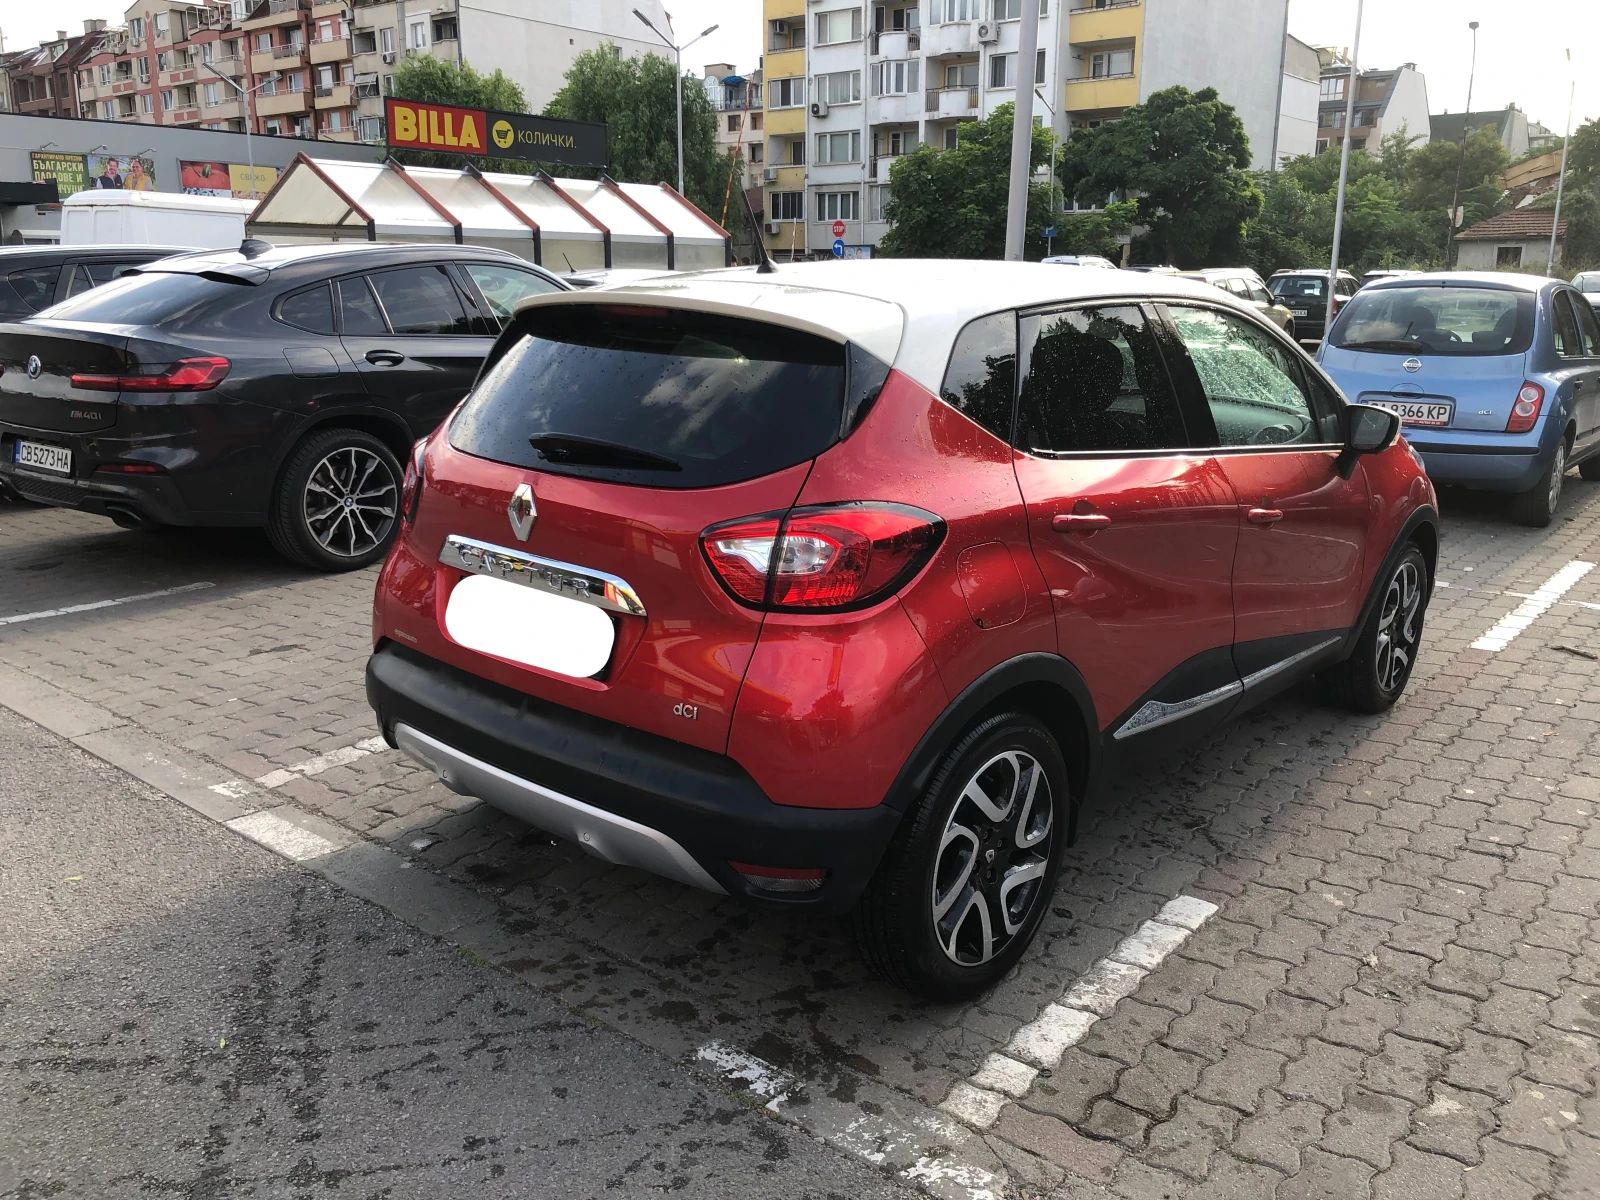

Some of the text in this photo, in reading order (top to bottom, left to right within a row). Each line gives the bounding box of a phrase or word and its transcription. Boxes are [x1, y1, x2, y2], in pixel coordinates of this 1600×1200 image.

[394, 106, 480, 148] BILLA
[33, 160, 84, 172] БЪЛГАРСКИ
[76, 173, 83, 183] И
[833, 225, 845, 233] STOP
[461, 549, 590, 598] CAPTUR
